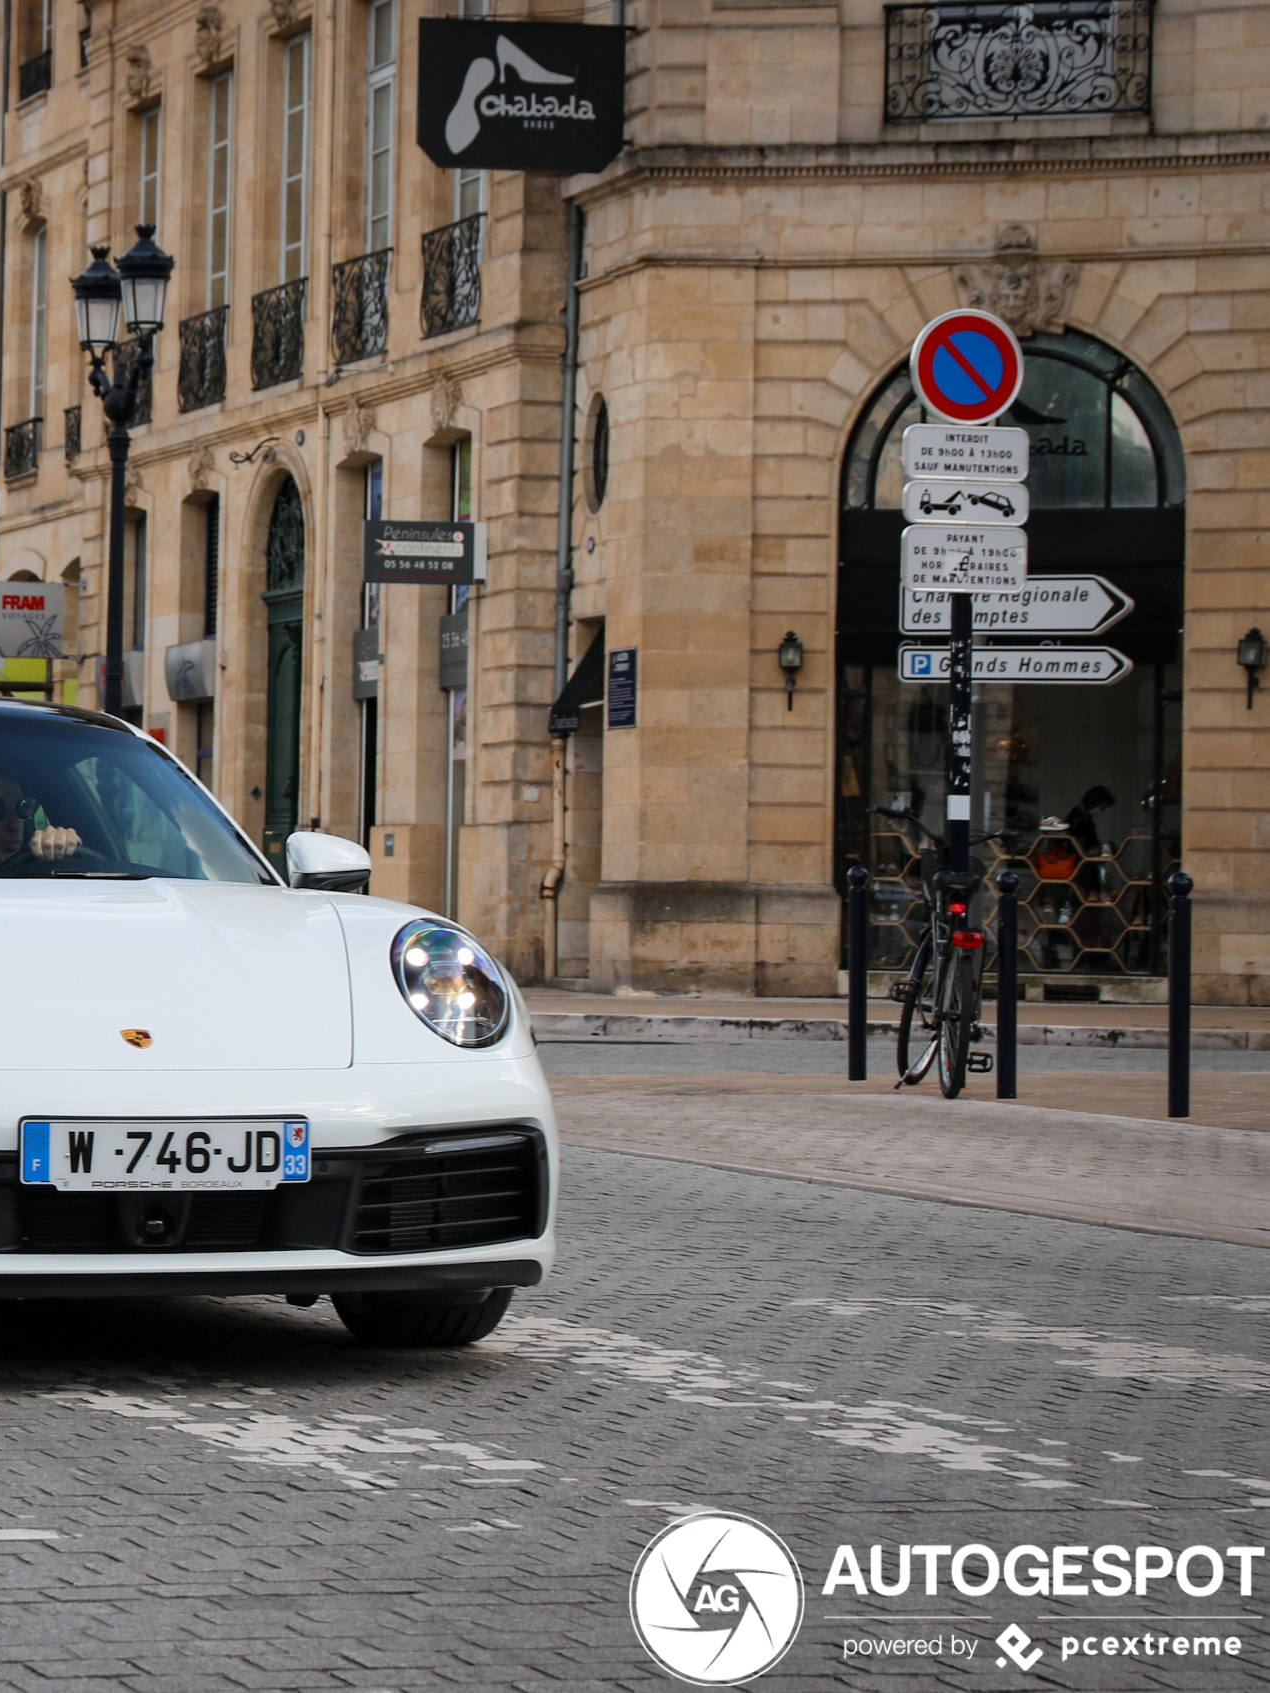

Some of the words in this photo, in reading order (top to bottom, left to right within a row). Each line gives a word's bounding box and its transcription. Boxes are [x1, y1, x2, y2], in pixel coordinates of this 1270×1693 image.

[480, 93, 596, 120] Chabada
[945, 433, 989, 443] INTERDIT
[921, 447, 933, 456] DE
[938, 448, 964, 457] 9h00
[981, 449, 1012, 459] 13h00
[914, 462, 939, 471] SAUF
[944, 463, 1019, 474] MANUTENTIONS
[946, 533, 985, 543] PAYANT
[913, 546, 927, 555] DE
[384, 559, 396, 569] 05
[399, 560, 411, 569] 56
[413, 560, 425, 569] 48
[427, 560, 439, 570] 52
[913, 574, 926, 583] DE
[2, 595, 45, 610] FRAM
[912, 592, 991, 604] Chare
[2, 612, 46, 620] VOYAGES
[912, 609, 942, 624] des
[940, 657, 1008, 673] Gnds
[1019, 657, 1102, 673] Hommes
[32, 1159, 41, 1172] F
[284, 1154, 306, 1175] 33
[181, 1180, 243, 1188] BORDEAUX
